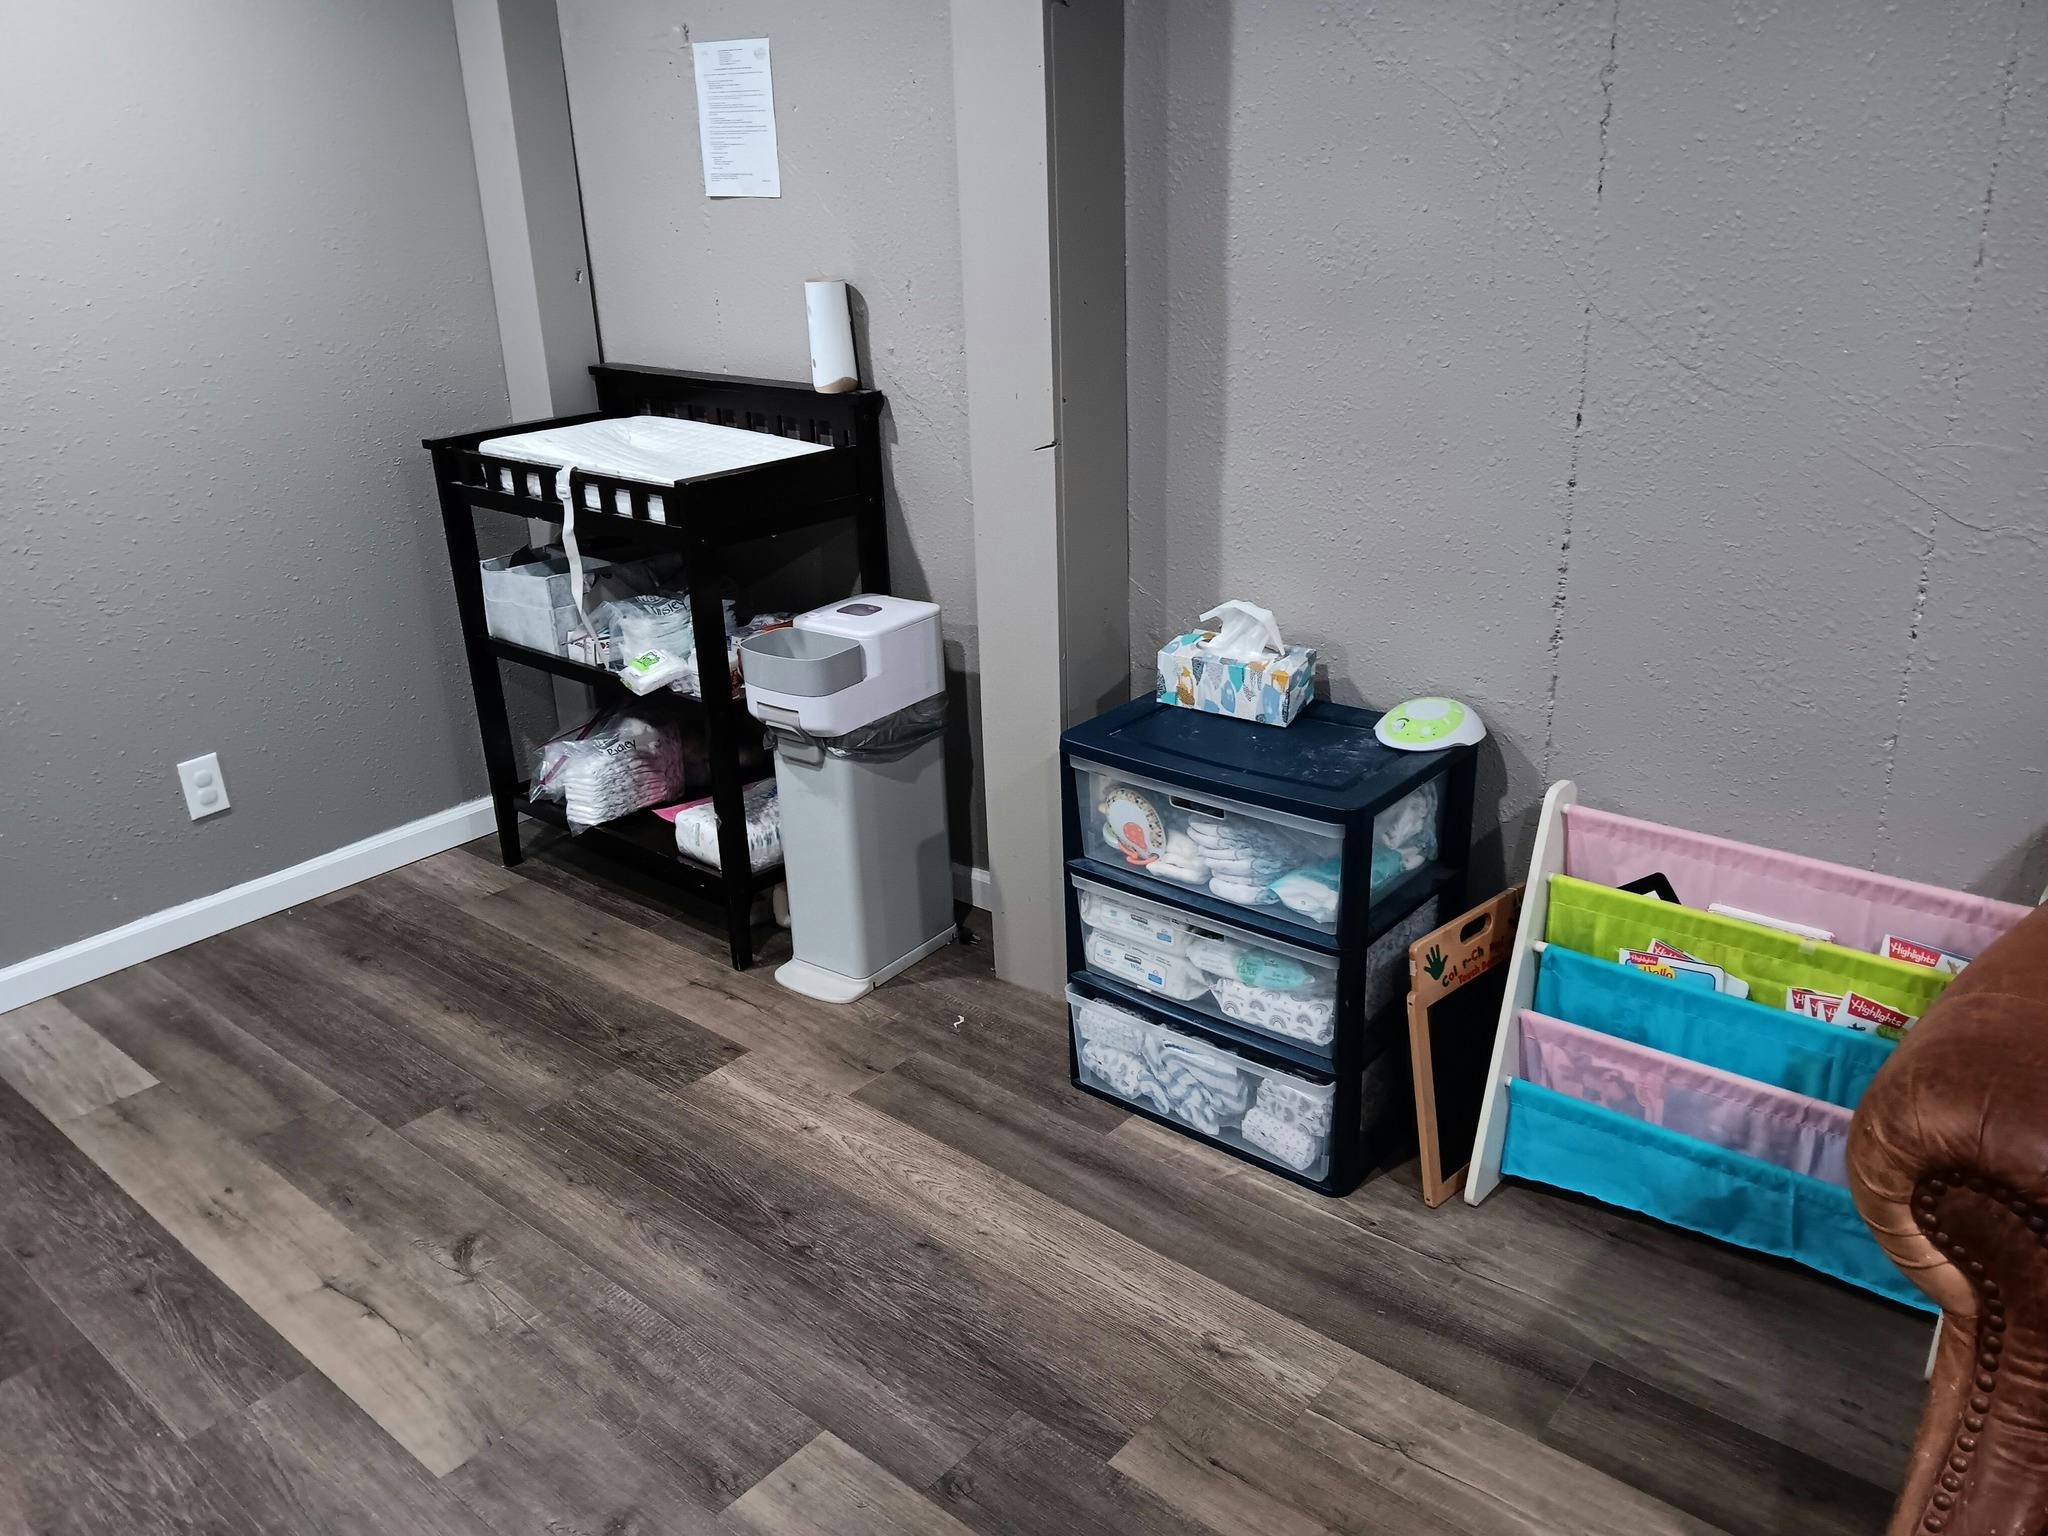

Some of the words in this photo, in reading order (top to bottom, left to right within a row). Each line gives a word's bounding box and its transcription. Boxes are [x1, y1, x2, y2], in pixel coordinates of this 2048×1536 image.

[1631, 954, 1657, 965] Highlights
[1890, 942, 1937, 965] Highlights
[1851, 999, 1902, 1027] Highlights
